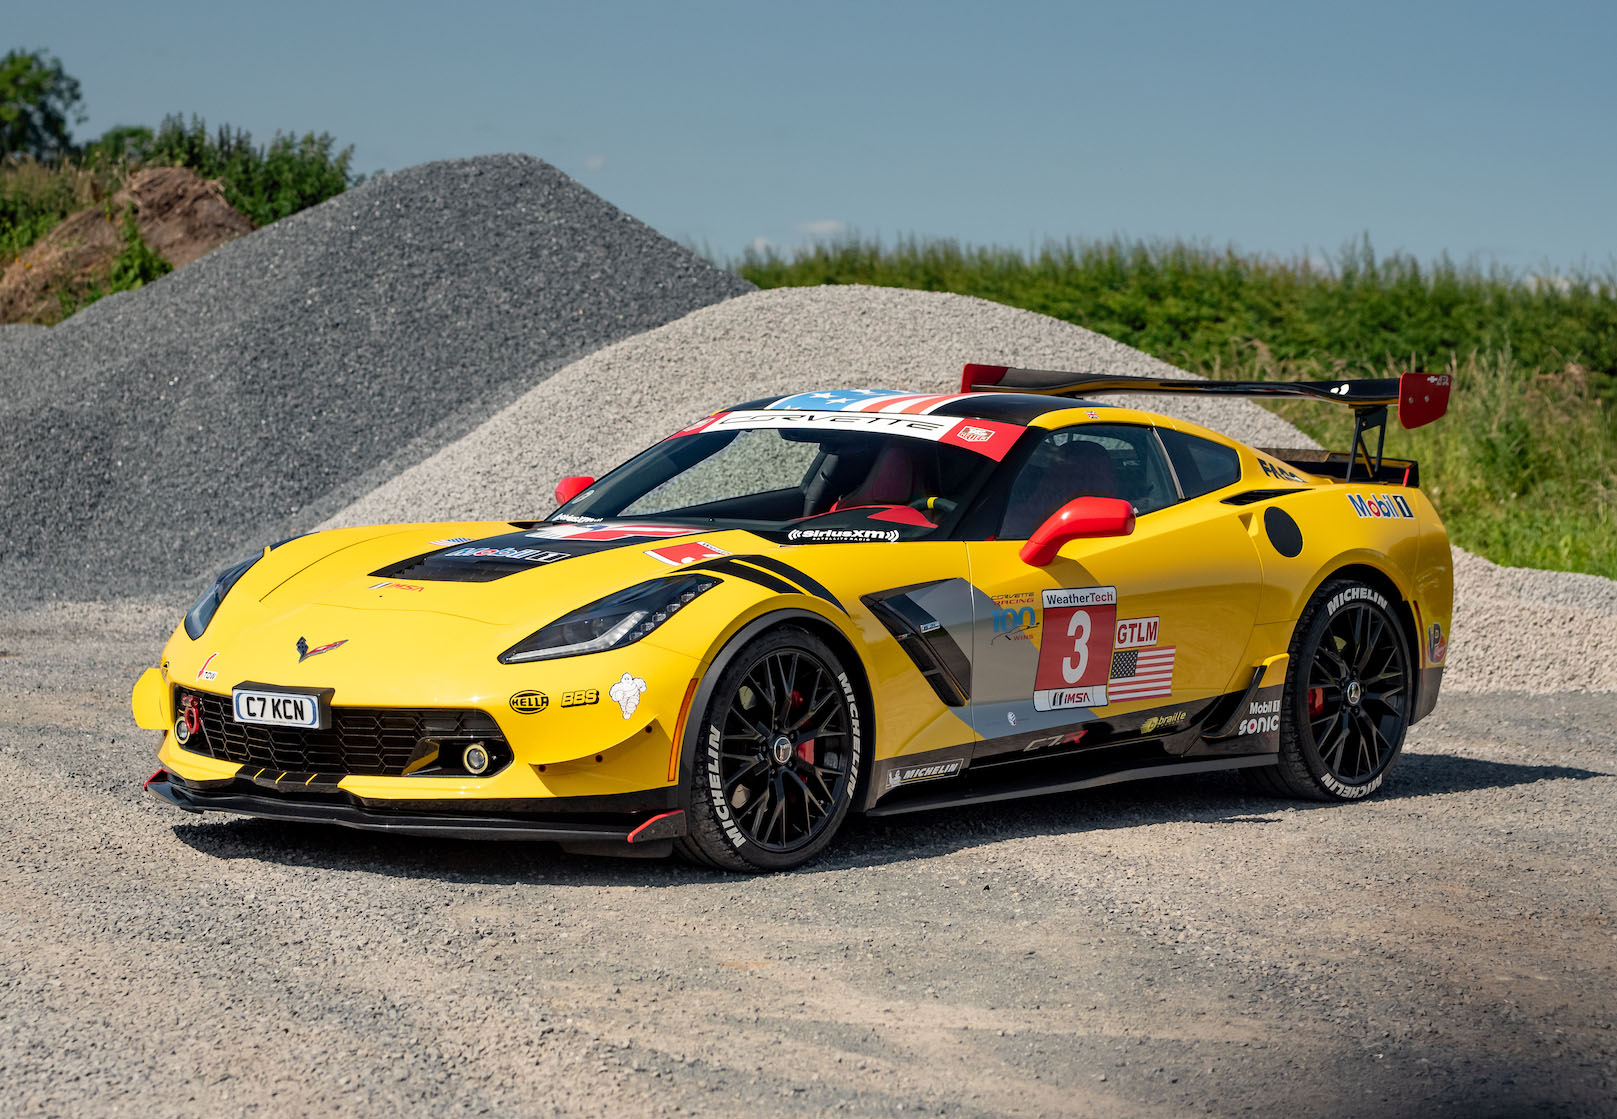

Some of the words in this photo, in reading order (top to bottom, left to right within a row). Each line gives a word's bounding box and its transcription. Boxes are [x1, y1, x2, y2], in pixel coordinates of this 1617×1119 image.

[719, 414, 944, 431] CORVETTE
[1346, 492, 1400, 519] Mobil
[1392, 494, 1416, 519] 1
[444, 547, 541, 560] Mobil
[992, 598, 1034, 607] RACING
[1046, 592, 1114, 605] WeatherTech
[1326, 586, 1388, 617] MICHELIN
[990, 606, 1036, 633] 100
[1116, 620, 1158, 645] GTLM
[1061, 609, 1092, 684] 3
[204, 671, 216, 680] TOW
[511, 695, 549, 708] HELLA
[560, 688, 600, 708] BBS
[1063, 692, 1091, 705] IMSA
[1249, 700, 1273, 715] Mobil
[1272, 699, 1281, 713] 1
[246, 696, 266, 718] C7
[271, 697, 305, 721] KCN
[1158, 711, 1187, 726] braille
[837, 671, 861, 800] MICHELIN
[902, 761, 959, 780] MICHELIN
[707, 724, 747, 848] MICHELIN
[1320, 772, 1383, 799] MICHELIN
